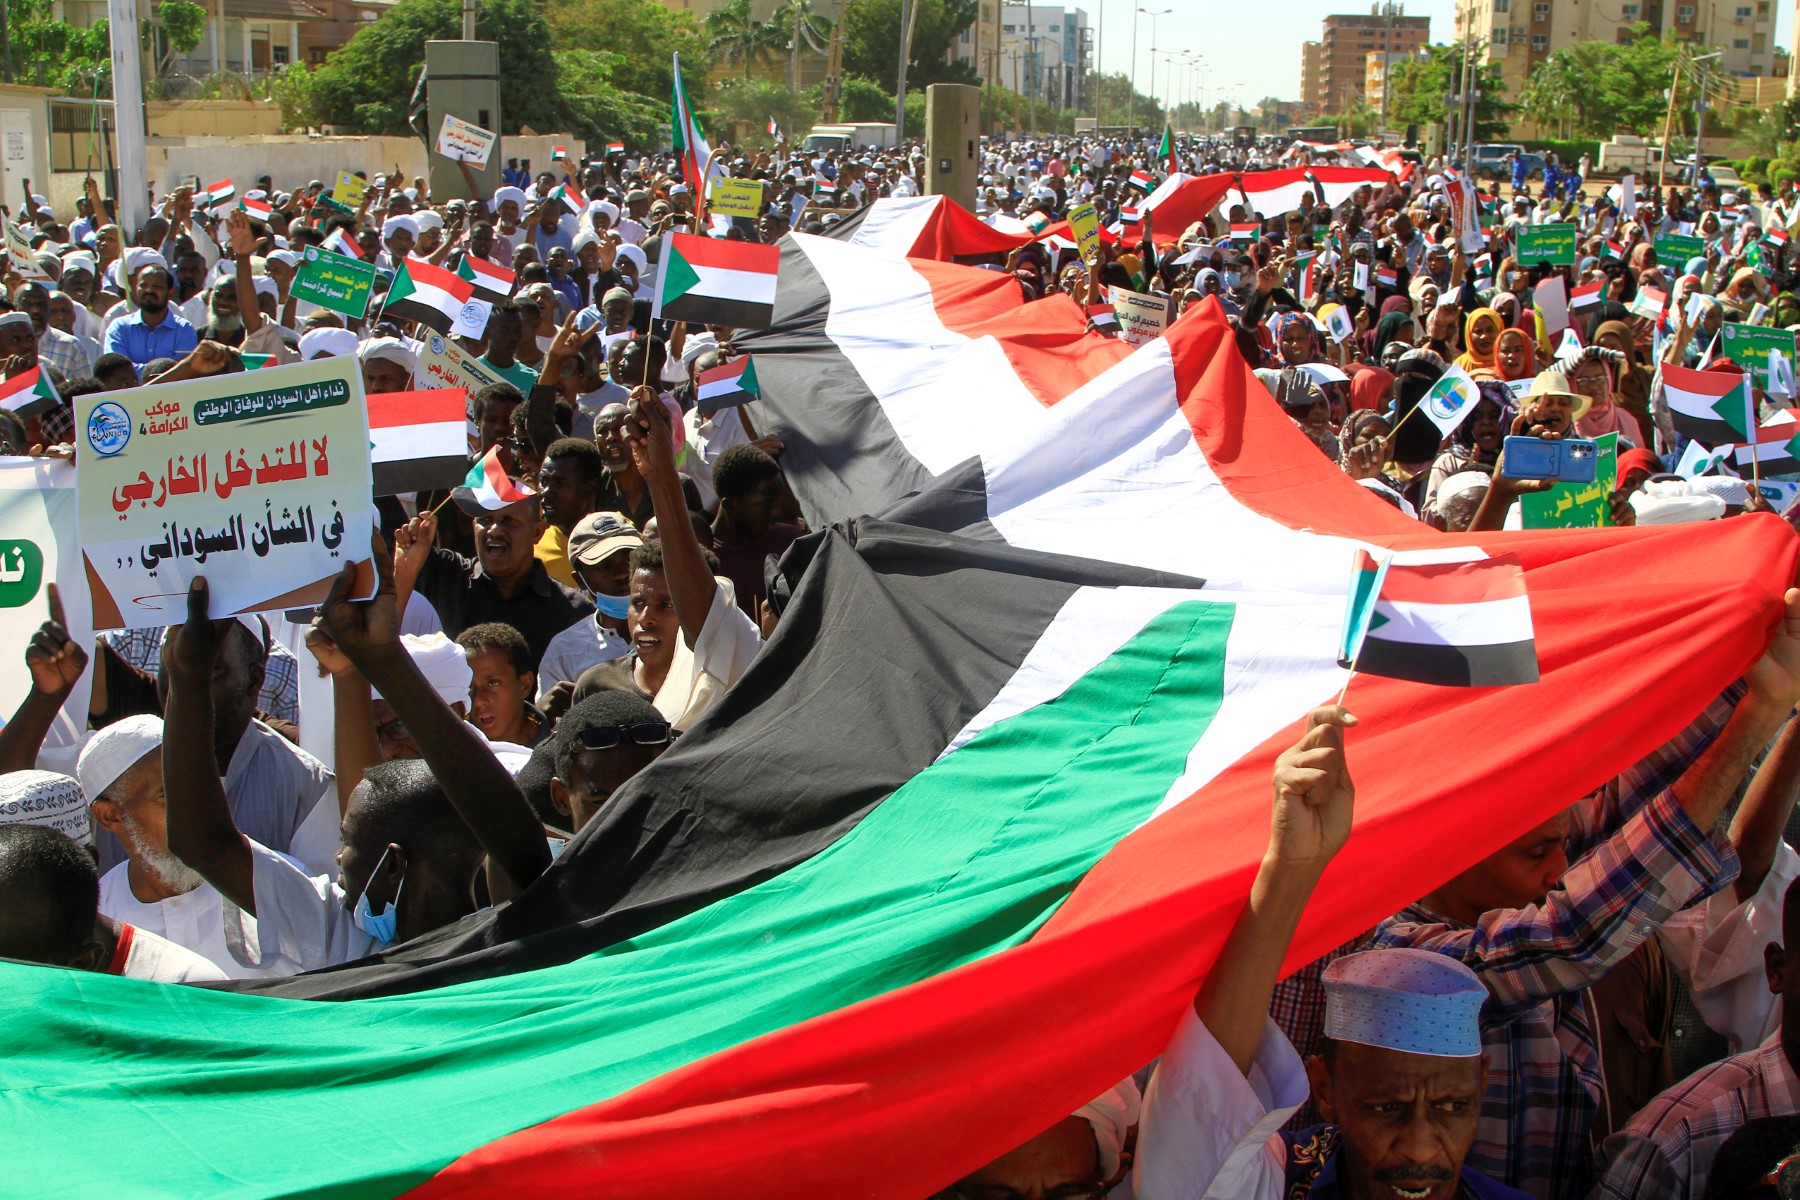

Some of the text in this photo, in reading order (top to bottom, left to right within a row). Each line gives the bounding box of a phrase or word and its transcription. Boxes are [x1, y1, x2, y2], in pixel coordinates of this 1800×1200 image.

[427, 362, 460, 386] الخارجي
[145, 400, 180, 419] موكب
[197, 382, 345, 423] نداء أهل السودان للوفاق الوطني
[139, 423, 147, 435] 4
[149, 416, 189, 435] الكرامة
[112, 435, 328, 521] لا للتدخل الخارجي
[1554, 489, 1574, 518] حر
[141, 513, 246, 577] السوداني
[252, 499, 315, 557] الشأن
[322, 500, 345, 557] في
